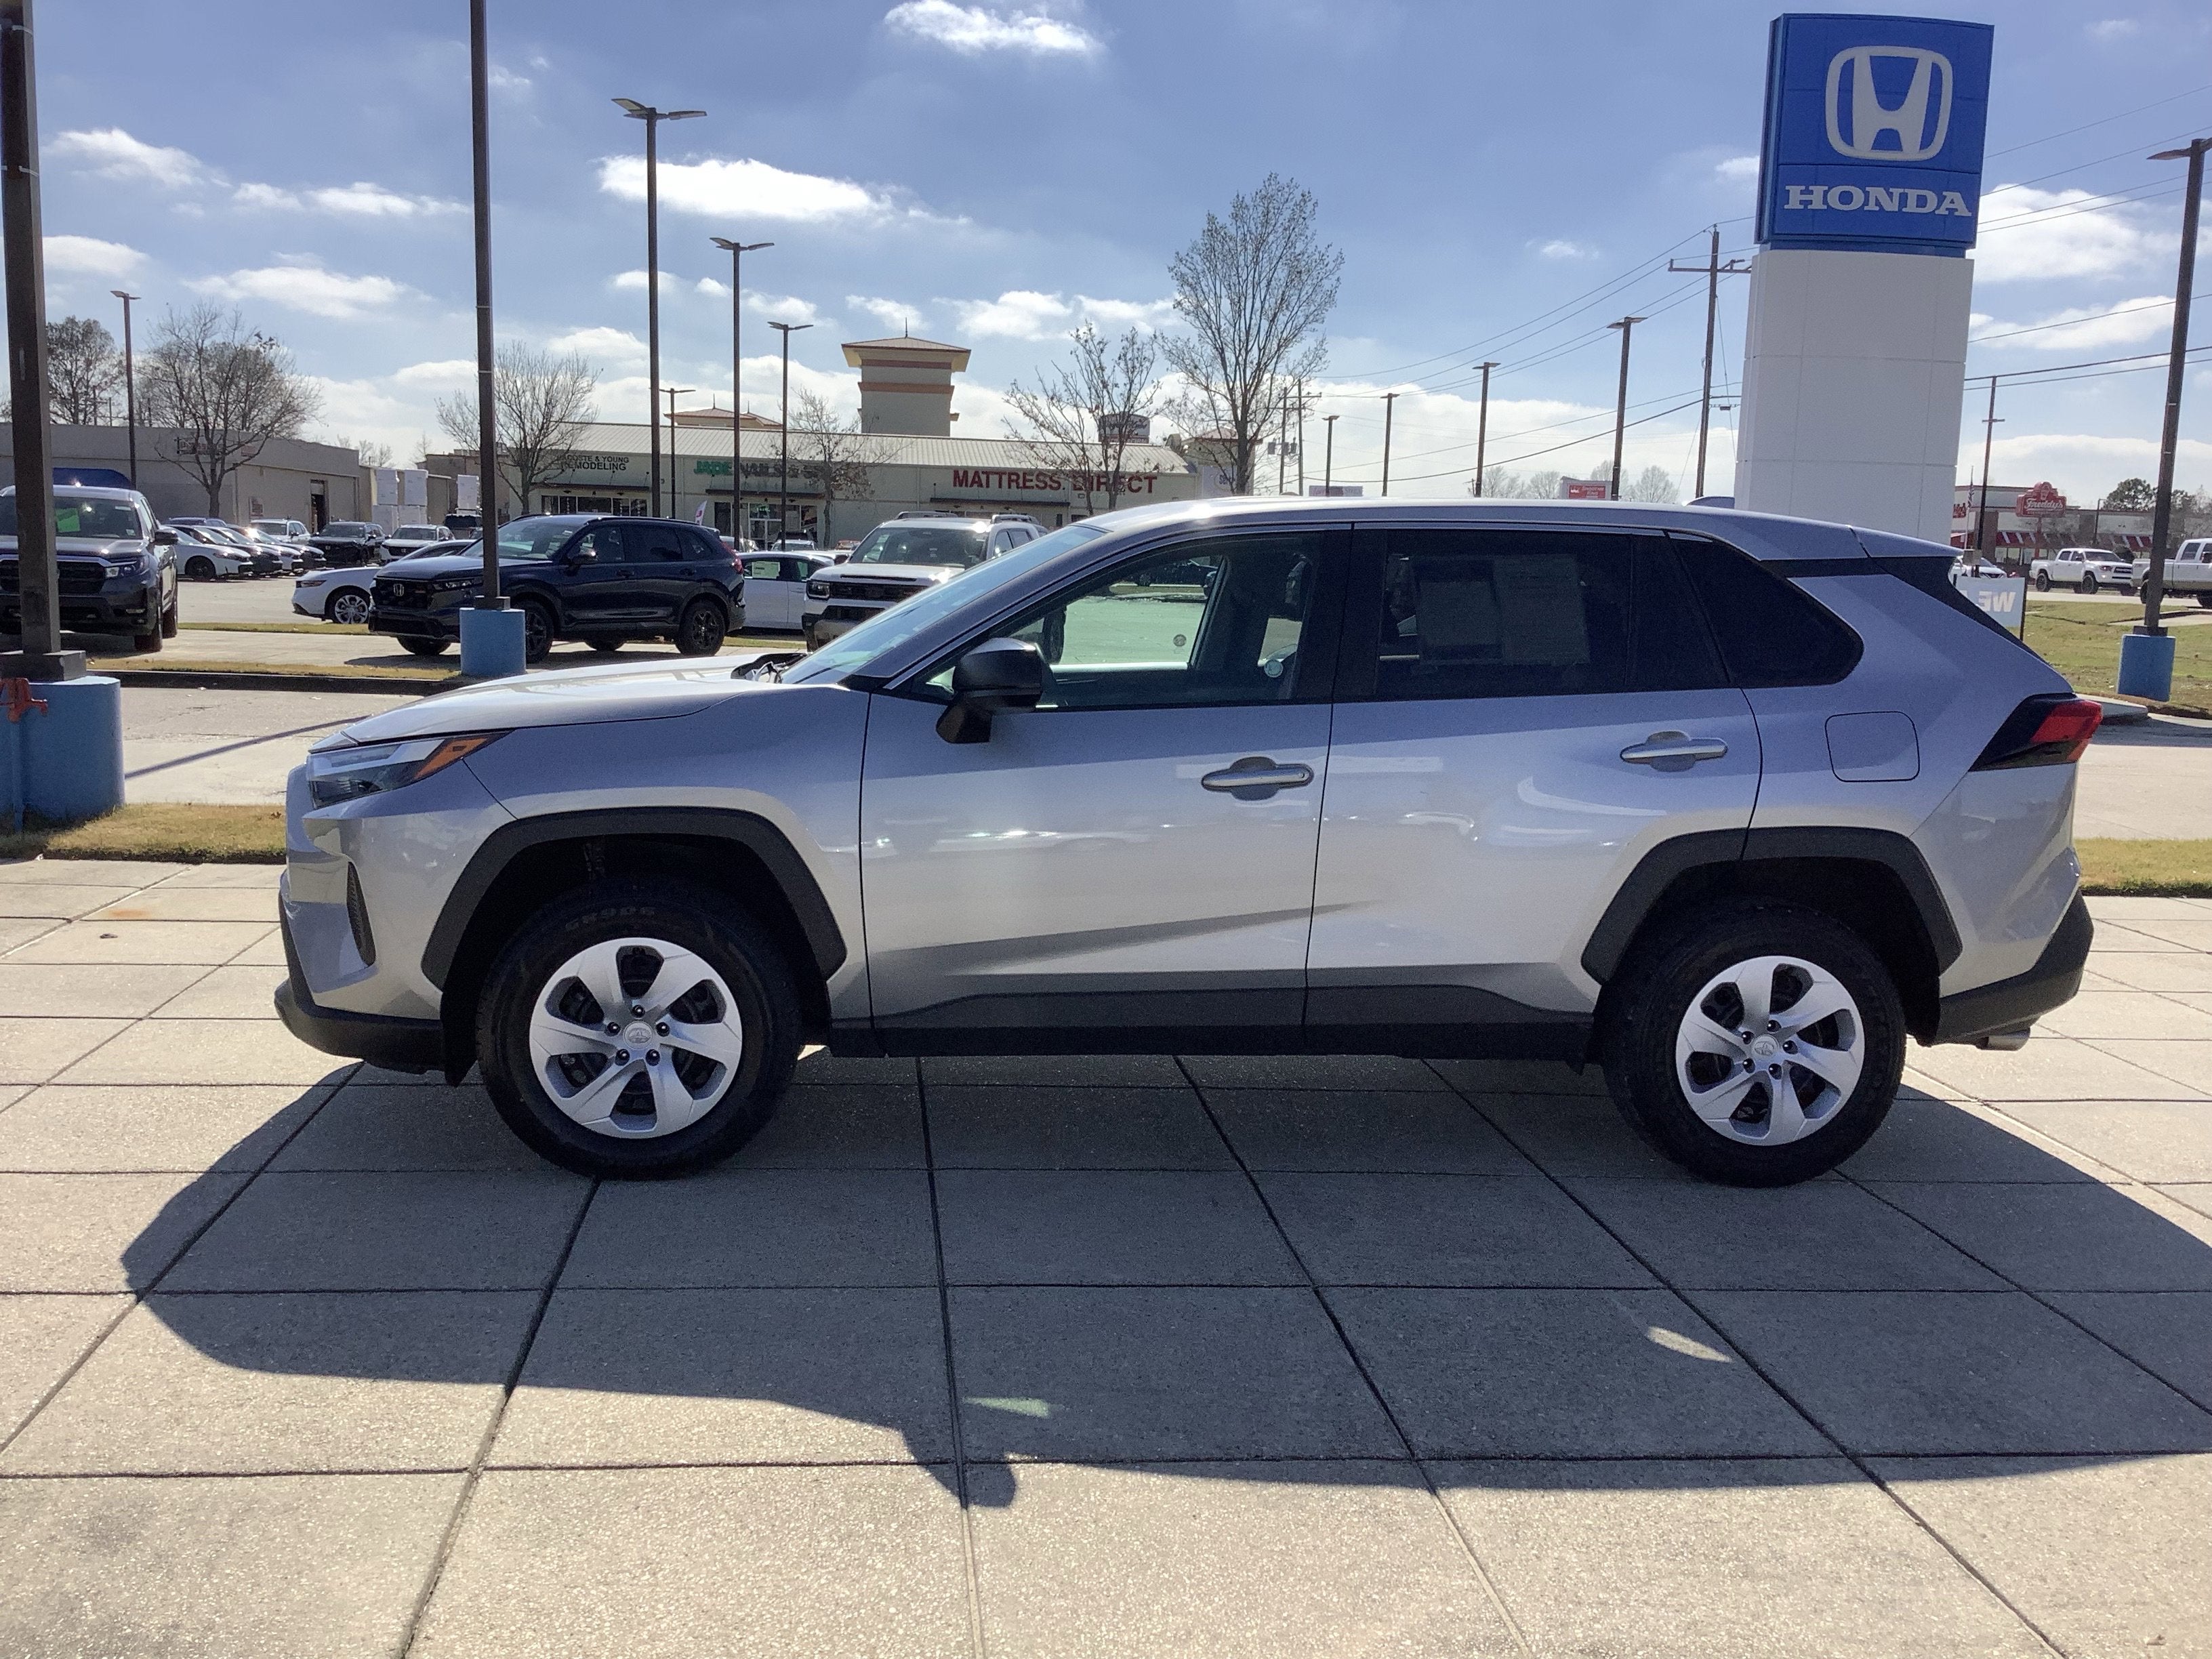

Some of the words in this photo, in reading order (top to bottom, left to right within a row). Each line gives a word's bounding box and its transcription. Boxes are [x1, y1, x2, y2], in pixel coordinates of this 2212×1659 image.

[1784, 185, 1972, 217] HONDA
[602, 455, 630, 464] YOUNG
[952, 469, 1062, 491] MATTRESS
[2024, 497, 2064, 510] Freddy's
